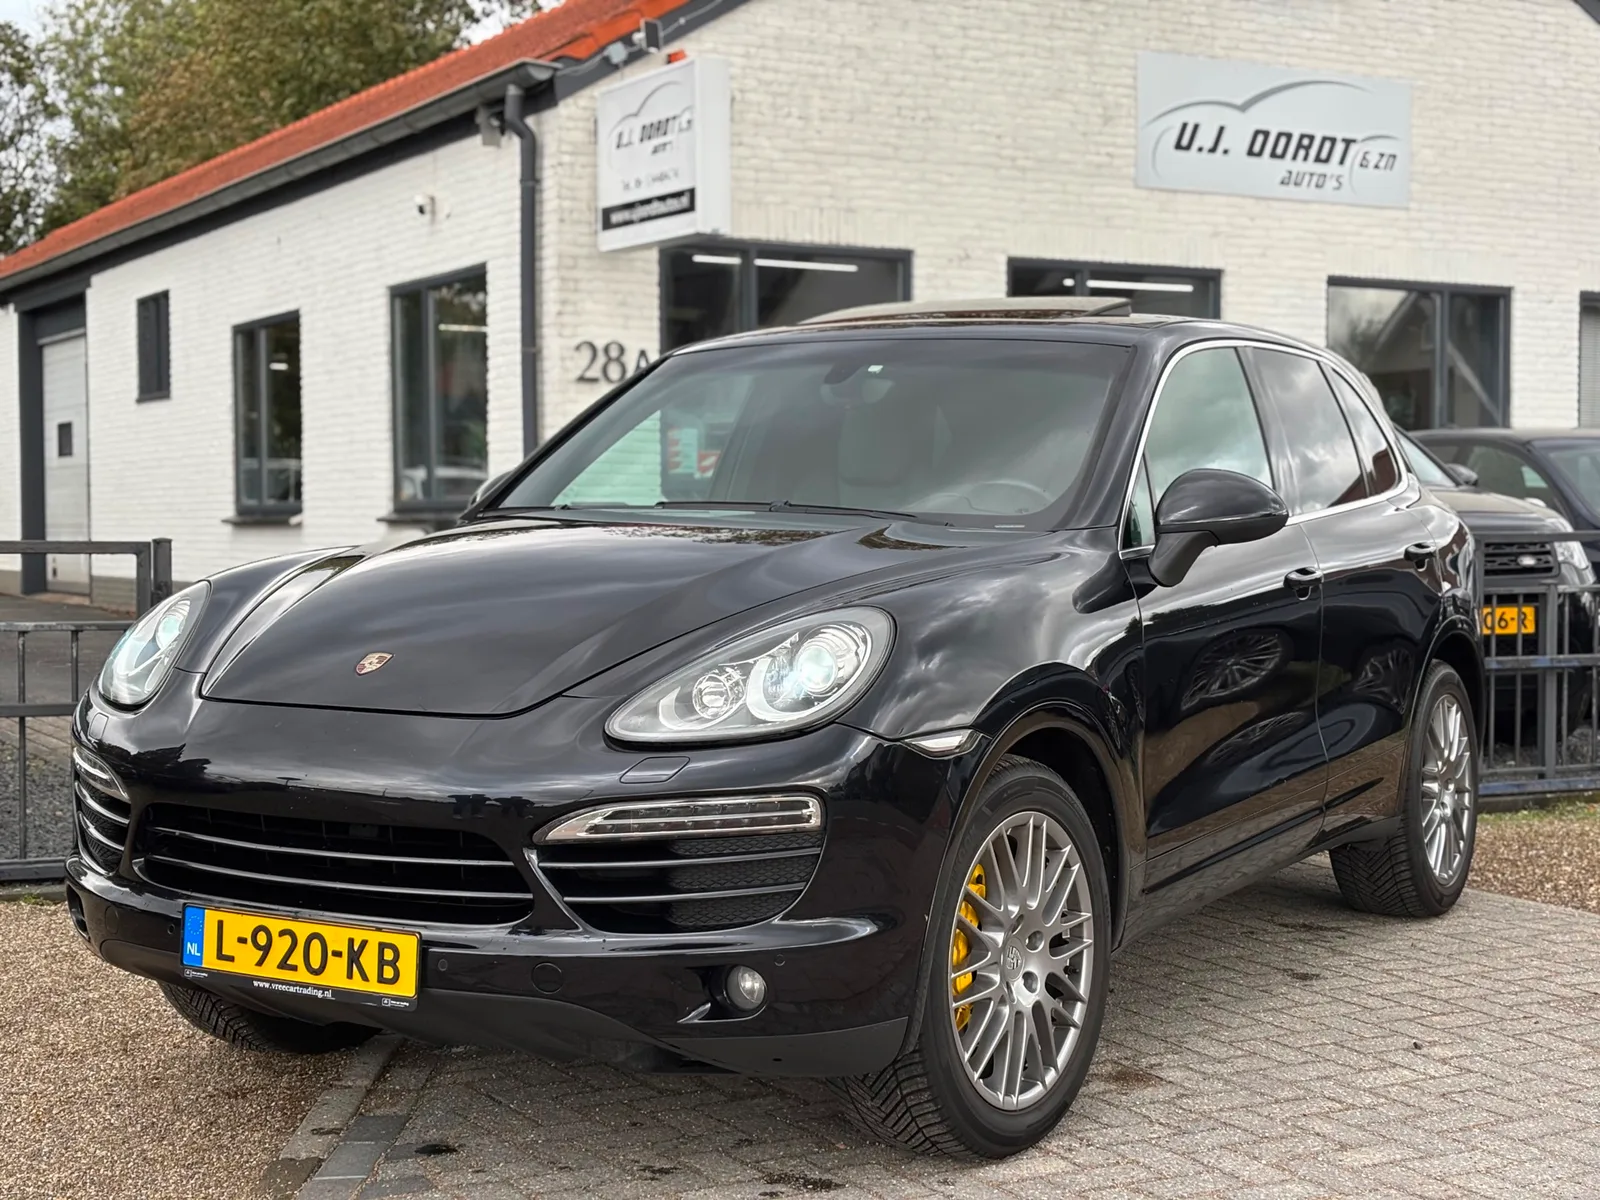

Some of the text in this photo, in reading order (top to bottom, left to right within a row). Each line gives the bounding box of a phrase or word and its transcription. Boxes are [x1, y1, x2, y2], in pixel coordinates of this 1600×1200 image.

[1173, 121, 1231, 156] U.J.
[1246, 129, 1358, 166] OORDT
[186, 941, 201, 957] NL
[216, 919, 401, 986] L-920-KB
[252, 980, 332, 998] www.vreecartrading.nl
